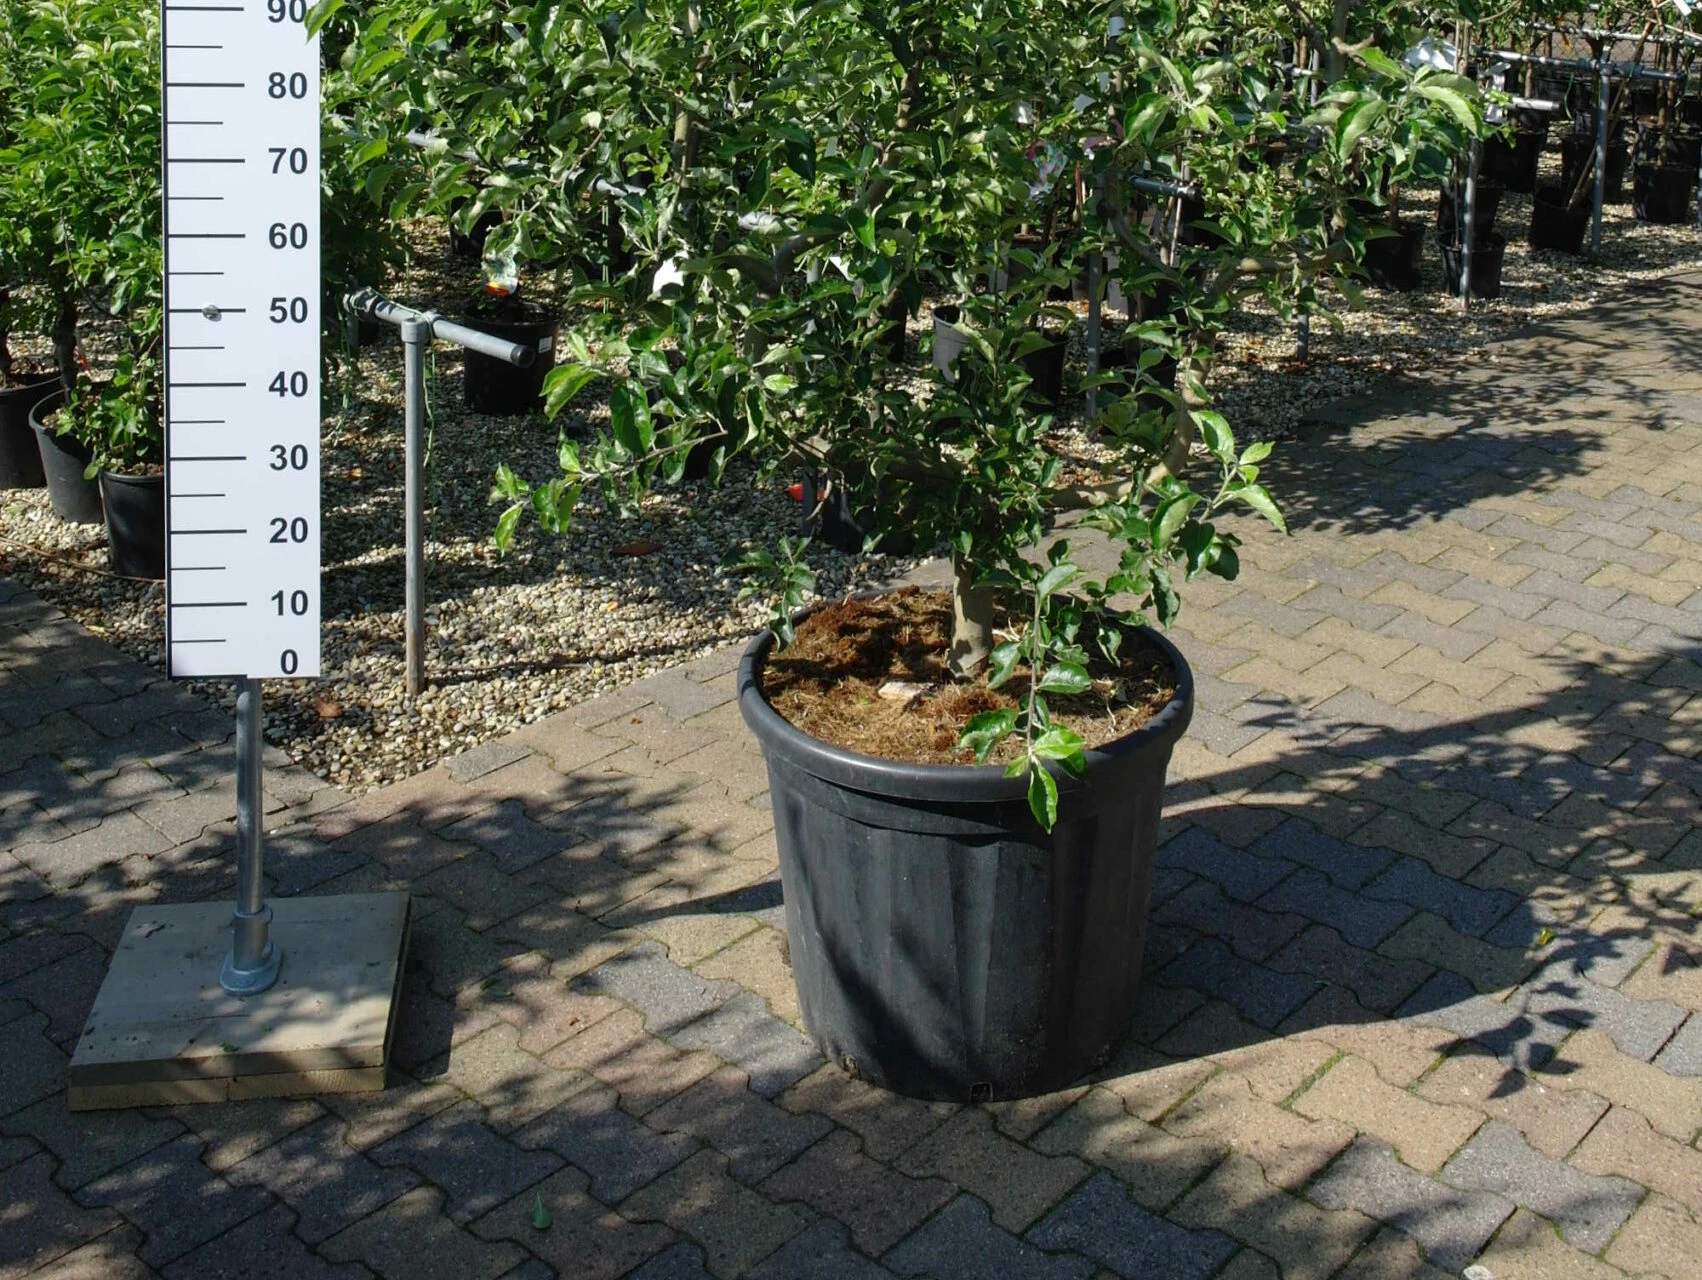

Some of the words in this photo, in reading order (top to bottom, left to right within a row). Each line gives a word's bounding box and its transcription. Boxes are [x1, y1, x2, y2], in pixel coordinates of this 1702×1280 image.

[268, 72, 308, 99] 80
[268, 147, 308, 175] 70
[268, 222, 308, 250] 60
[269, 297, 308, 324] 50
[268, 371, 308, 398] 40
[269, 444, 308, 471] 30
[269, 517, 309, 544] 20
[271, 589, 309, 616] 10
[280, 649, 299, 675] 0
